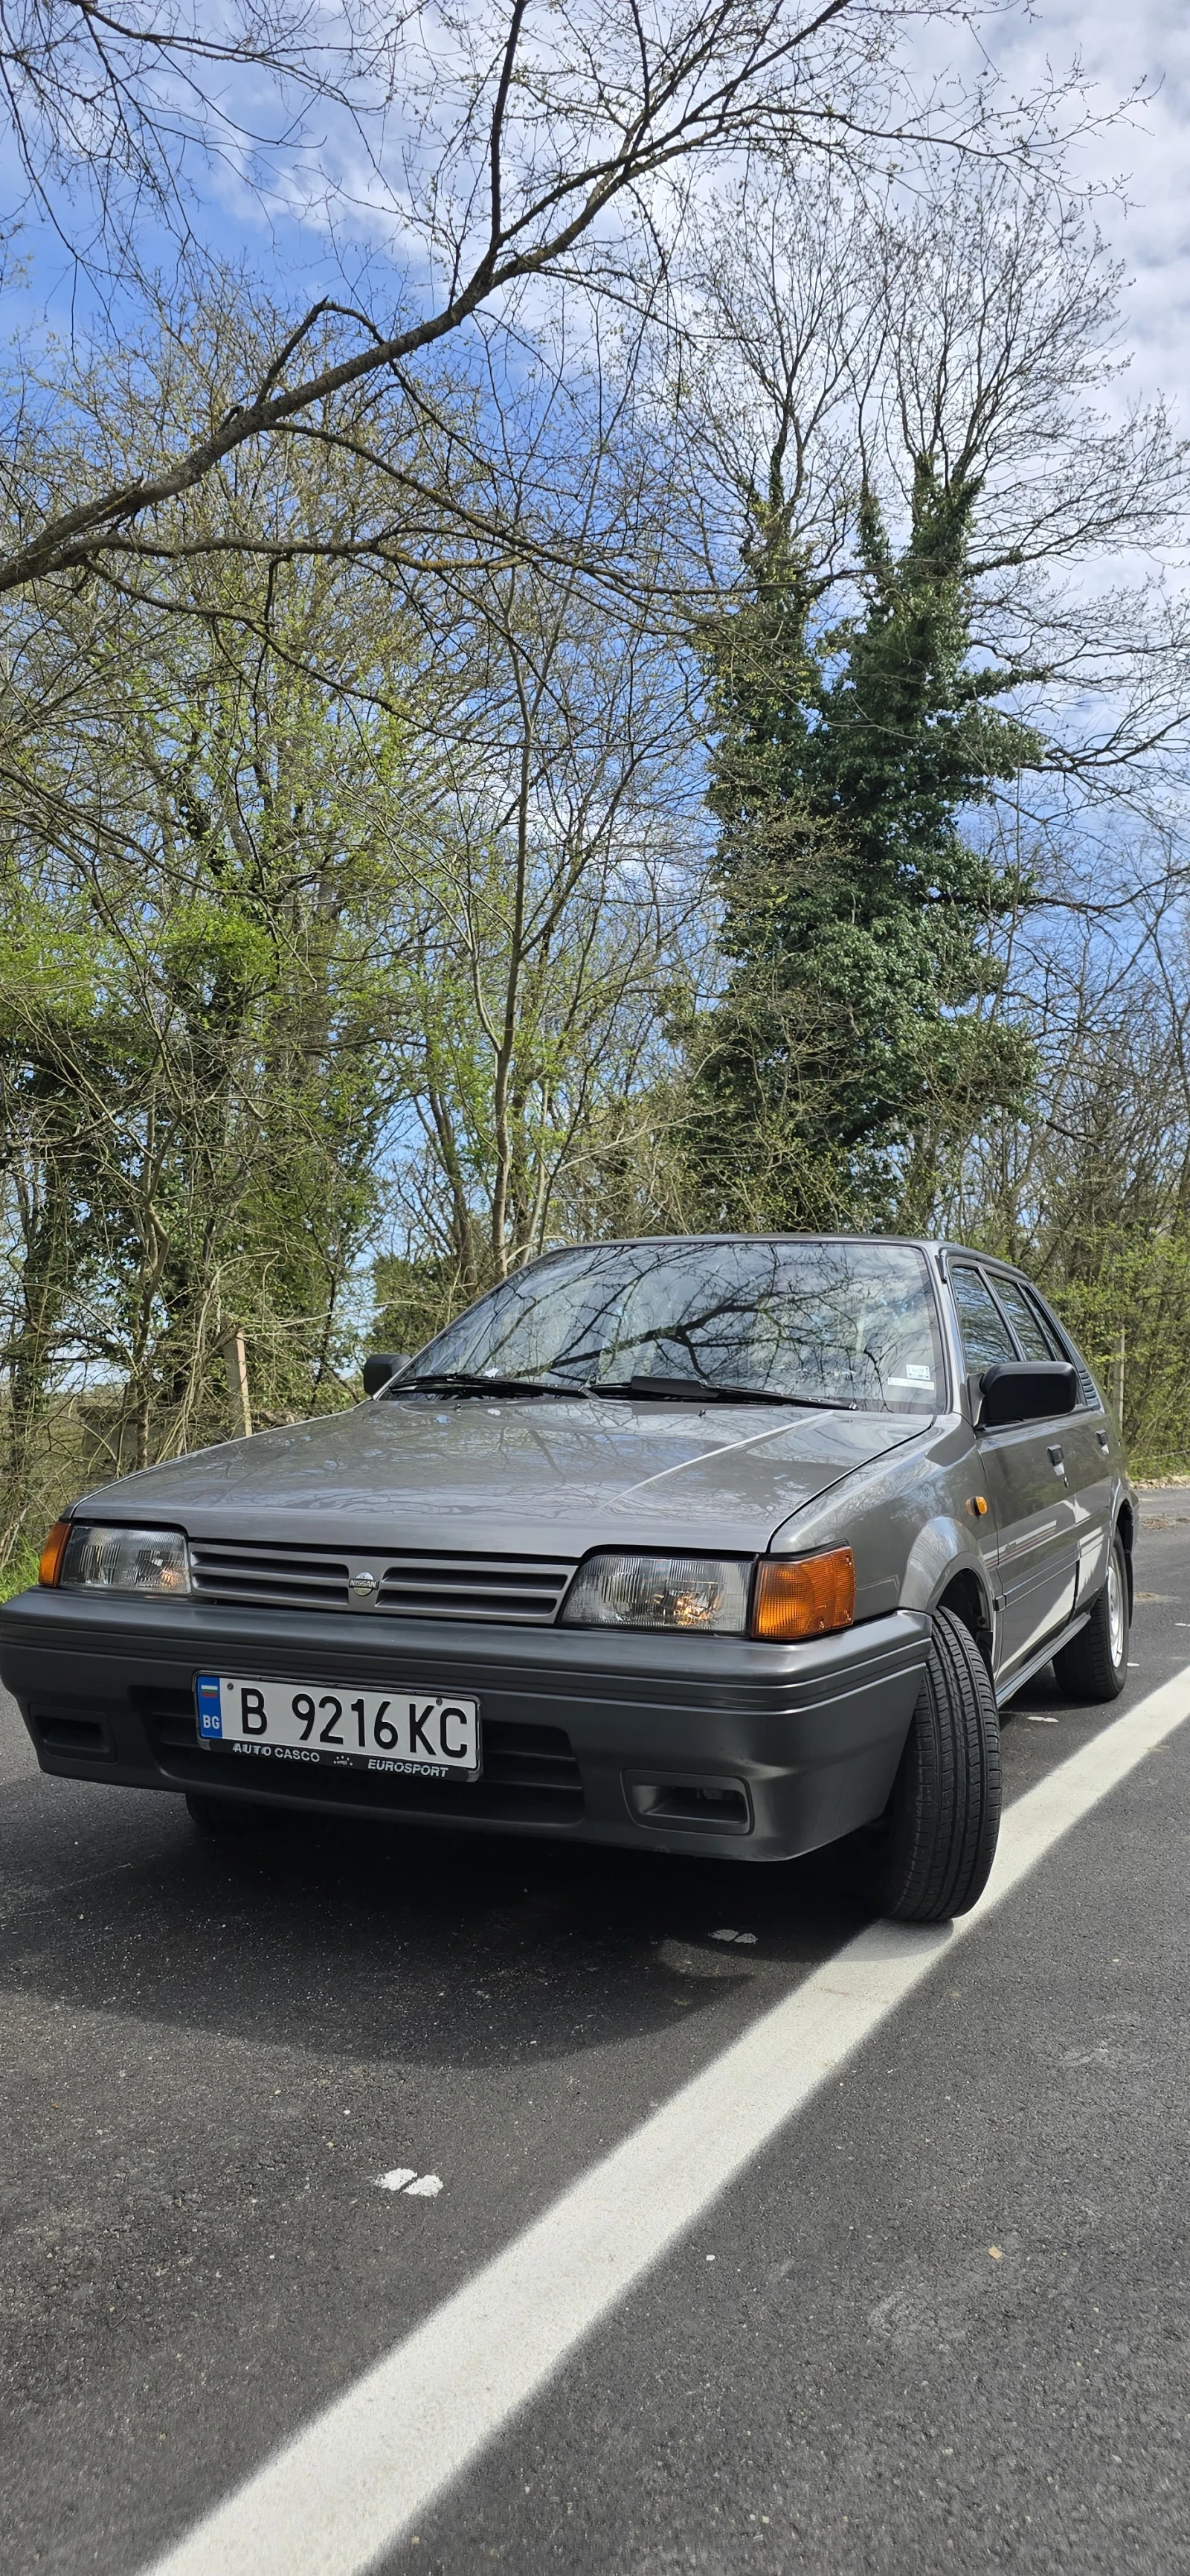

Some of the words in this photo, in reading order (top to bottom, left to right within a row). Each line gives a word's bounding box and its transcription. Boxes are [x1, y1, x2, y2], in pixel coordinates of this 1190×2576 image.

[350, 1579, 376, 1588] NISSAN
[202, 1715, 220, 1729] BG
[241, 1687, 268, 1735] B
[232, 1743, 271, 1756] AUTO
[274, 1748, 321, 1762] CASCO
[367, 1759, 449, 1778] EUROSPORT
